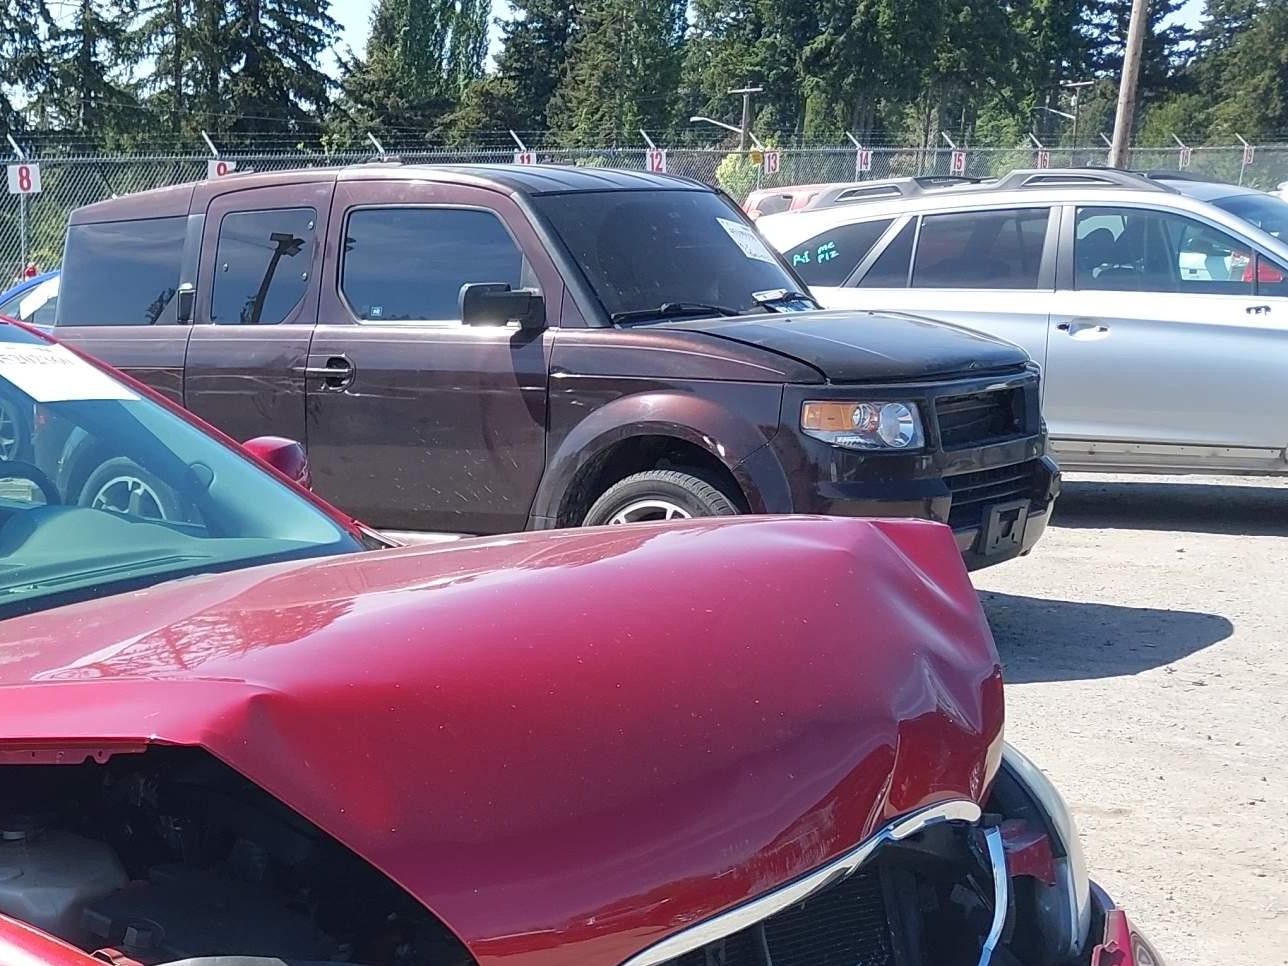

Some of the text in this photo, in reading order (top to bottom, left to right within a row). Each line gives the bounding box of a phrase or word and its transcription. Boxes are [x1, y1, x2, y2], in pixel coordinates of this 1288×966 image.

[648, 151, 663, 172] 12
[767, 153, 778, 173] 13
[858, 150, 870, 170] 14
[953, 152, 963, 170] 15
[1040, 152, 1048, 169] 16
[17, 166, 32, 192] 8
